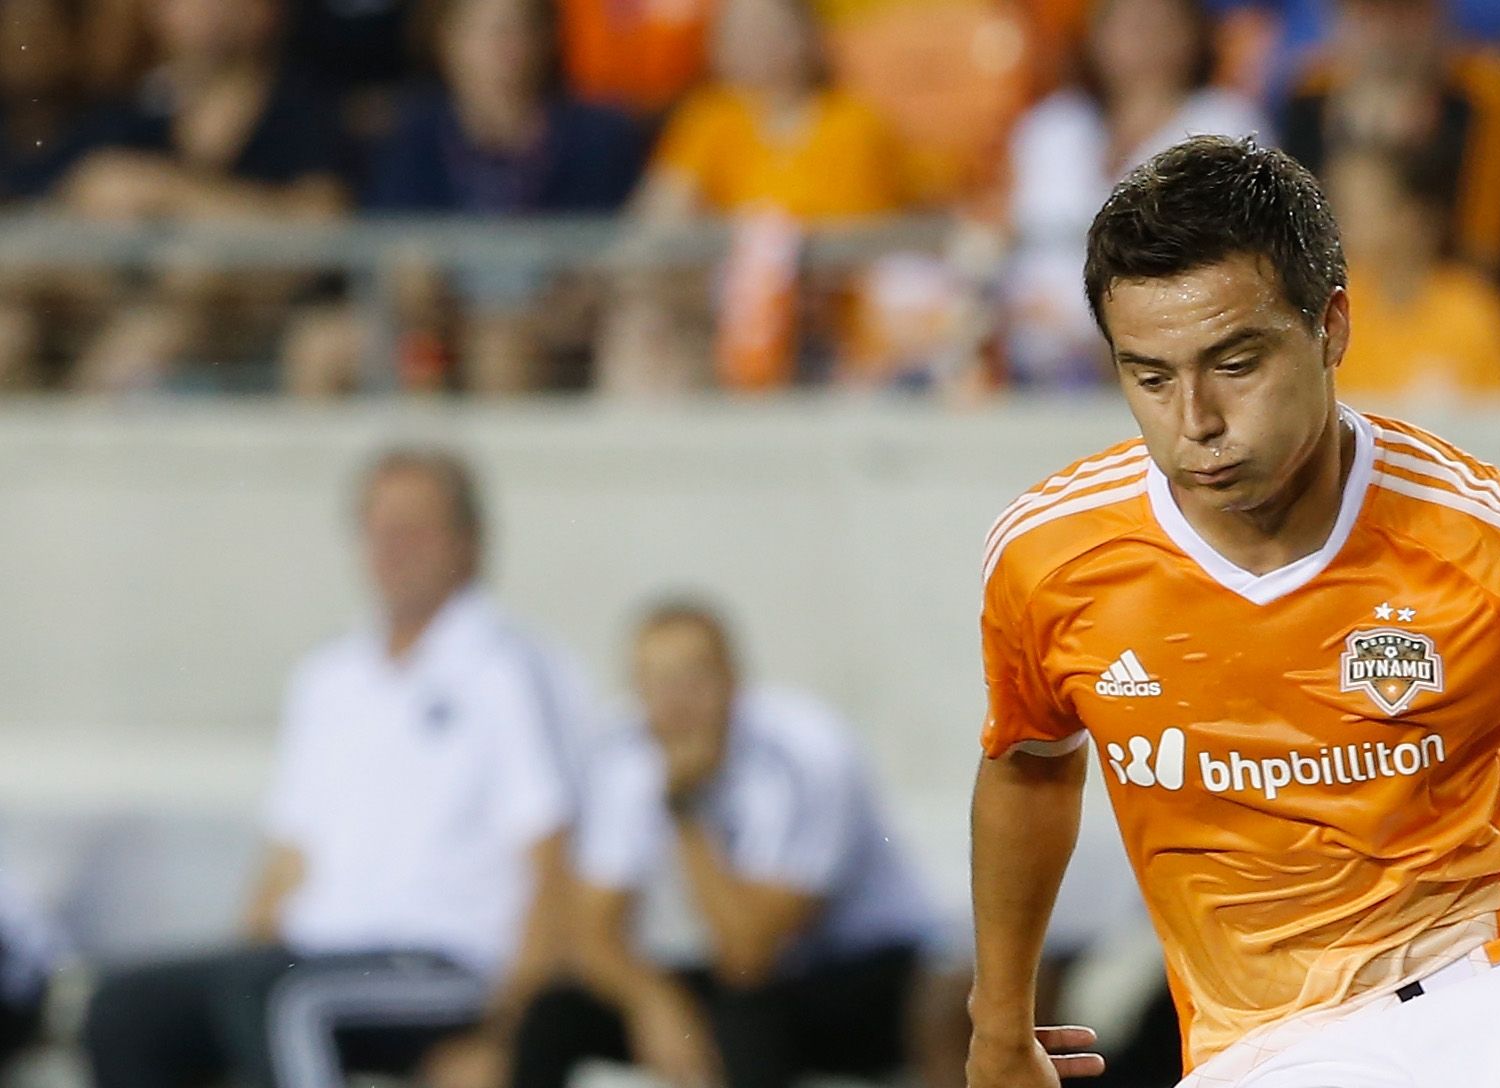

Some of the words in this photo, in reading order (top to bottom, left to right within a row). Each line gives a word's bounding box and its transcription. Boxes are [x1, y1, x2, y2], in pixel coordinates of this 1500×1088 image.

[1352, 659, 1431, 679] DYNAMO
[1096, 680, 1161, 697] adidas
[1199, 733, 1445, 799] bhpbilliton
